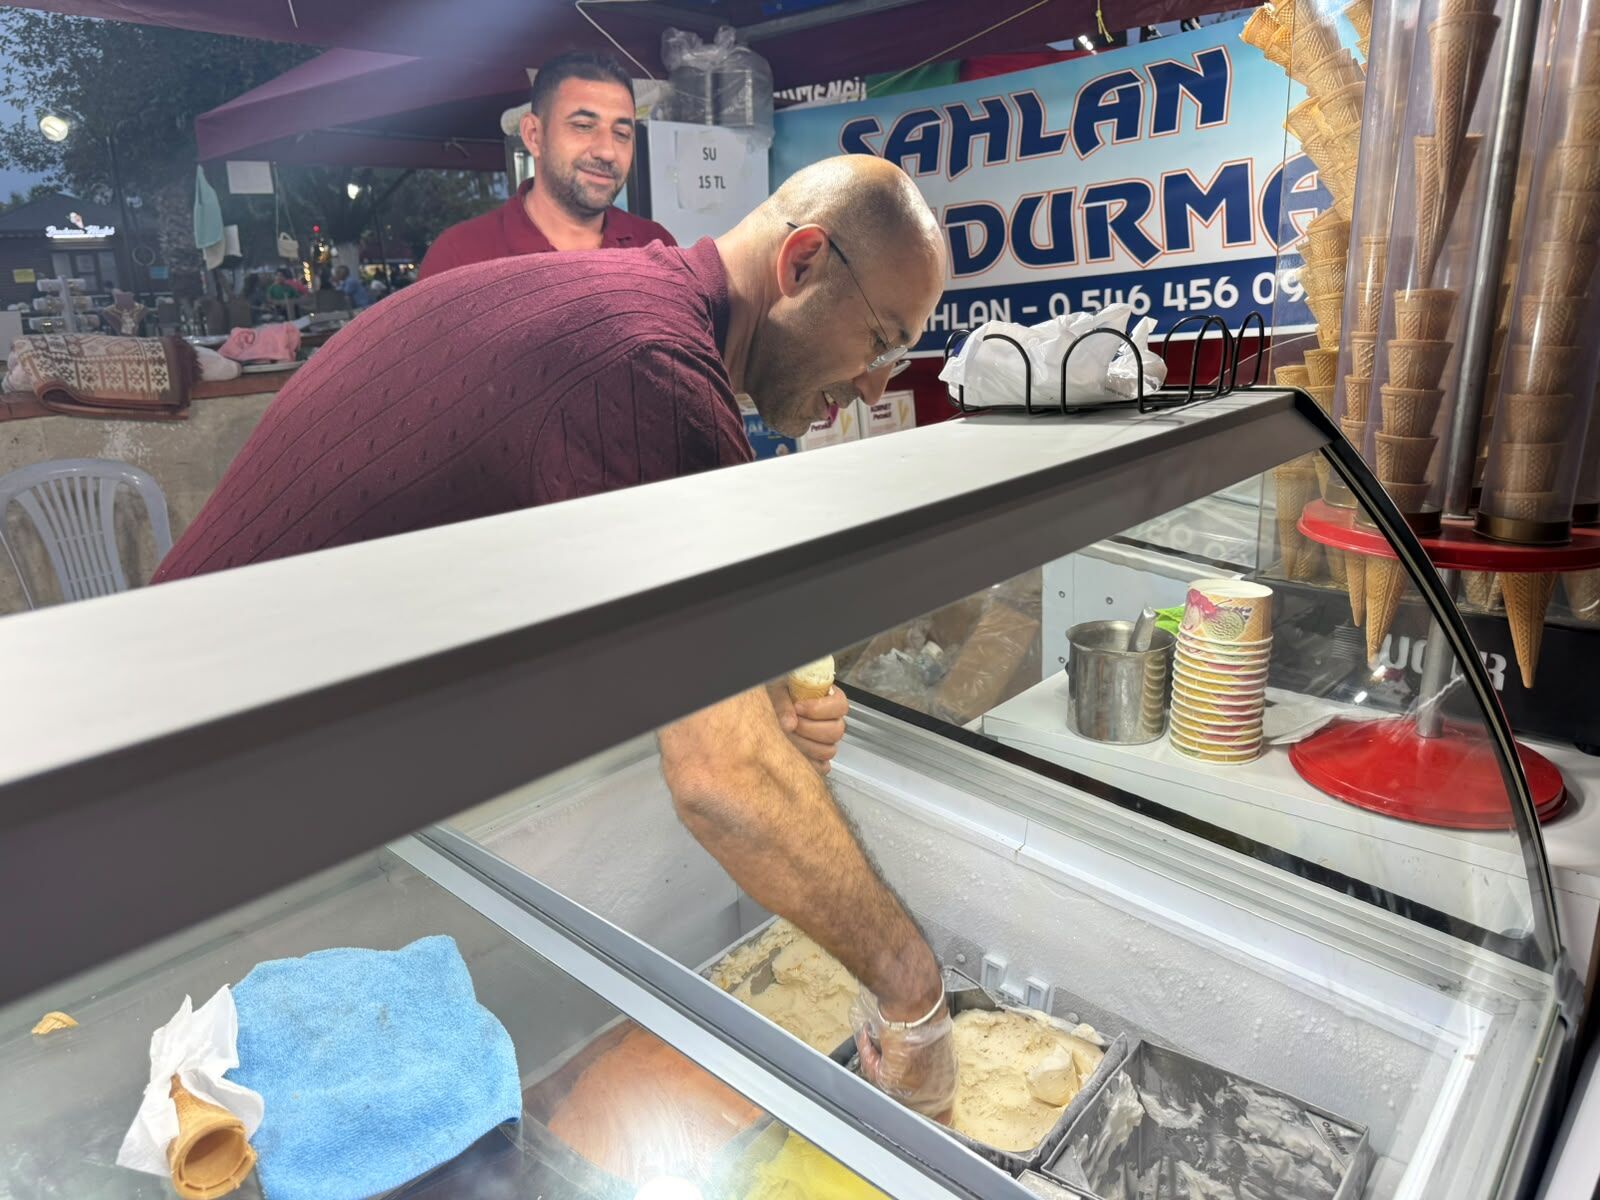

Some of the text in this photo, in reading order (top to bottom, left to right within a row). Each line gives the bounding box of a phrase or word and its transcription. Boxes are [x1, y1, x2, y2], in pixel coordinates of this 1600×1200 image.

[838, 45, 1231, 182] SAHLAN
[699, 175, 726, 189] 15 TL
[702, 147, 717, 161] SU
[932, 151, 1334, 279] DURMA
[923, 297, 1011, 333] HLAN
[1162, 276, 1239, 312] 456
